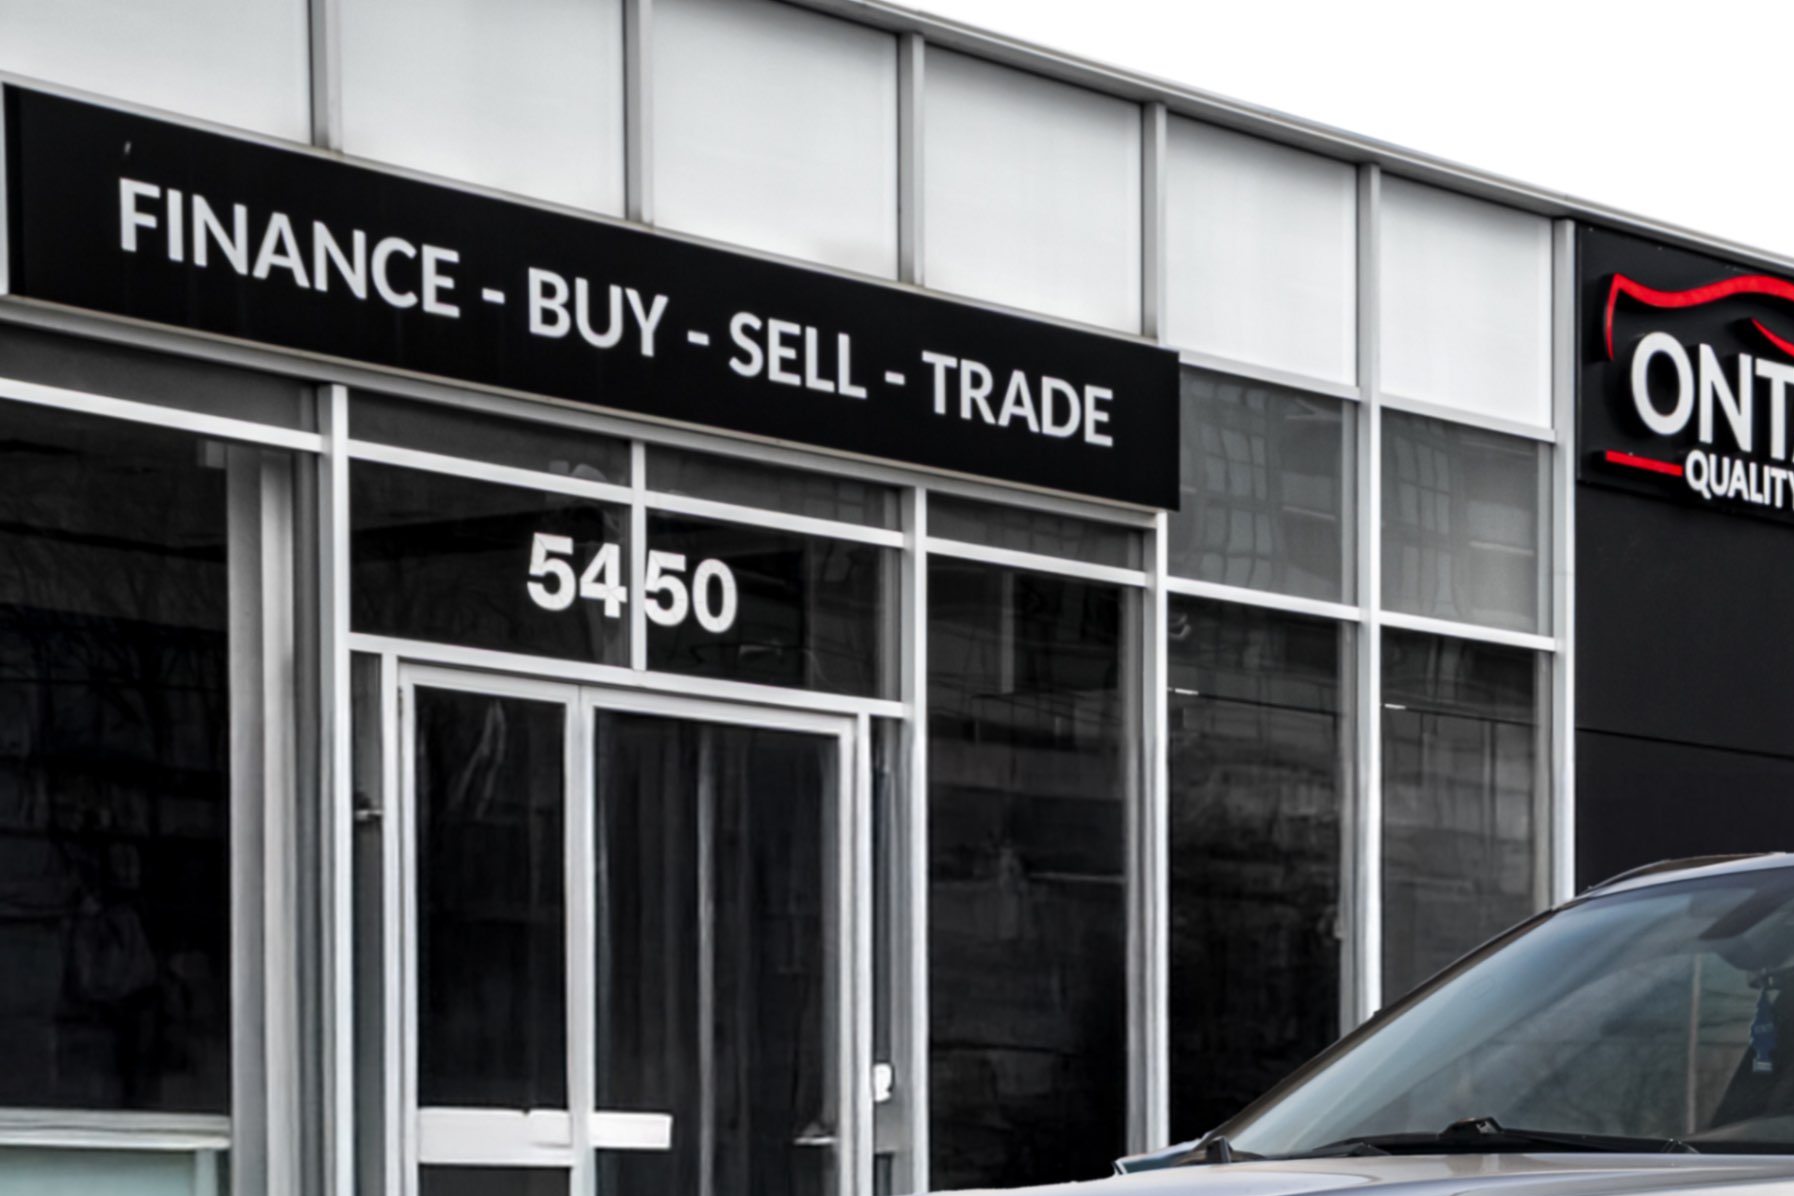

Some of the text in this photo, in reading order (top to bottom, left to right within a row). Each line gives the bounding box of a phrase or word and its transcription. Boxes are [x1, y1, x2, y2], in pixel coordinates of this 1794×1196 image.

[118, 177, 461, 318] FINANCE
[528, 266, 669, 357] BUY
[728, 311, 868, 399] SELL
[921, 350, 1114, 447] TRADE
[526, 532, 738, 633] 5450
